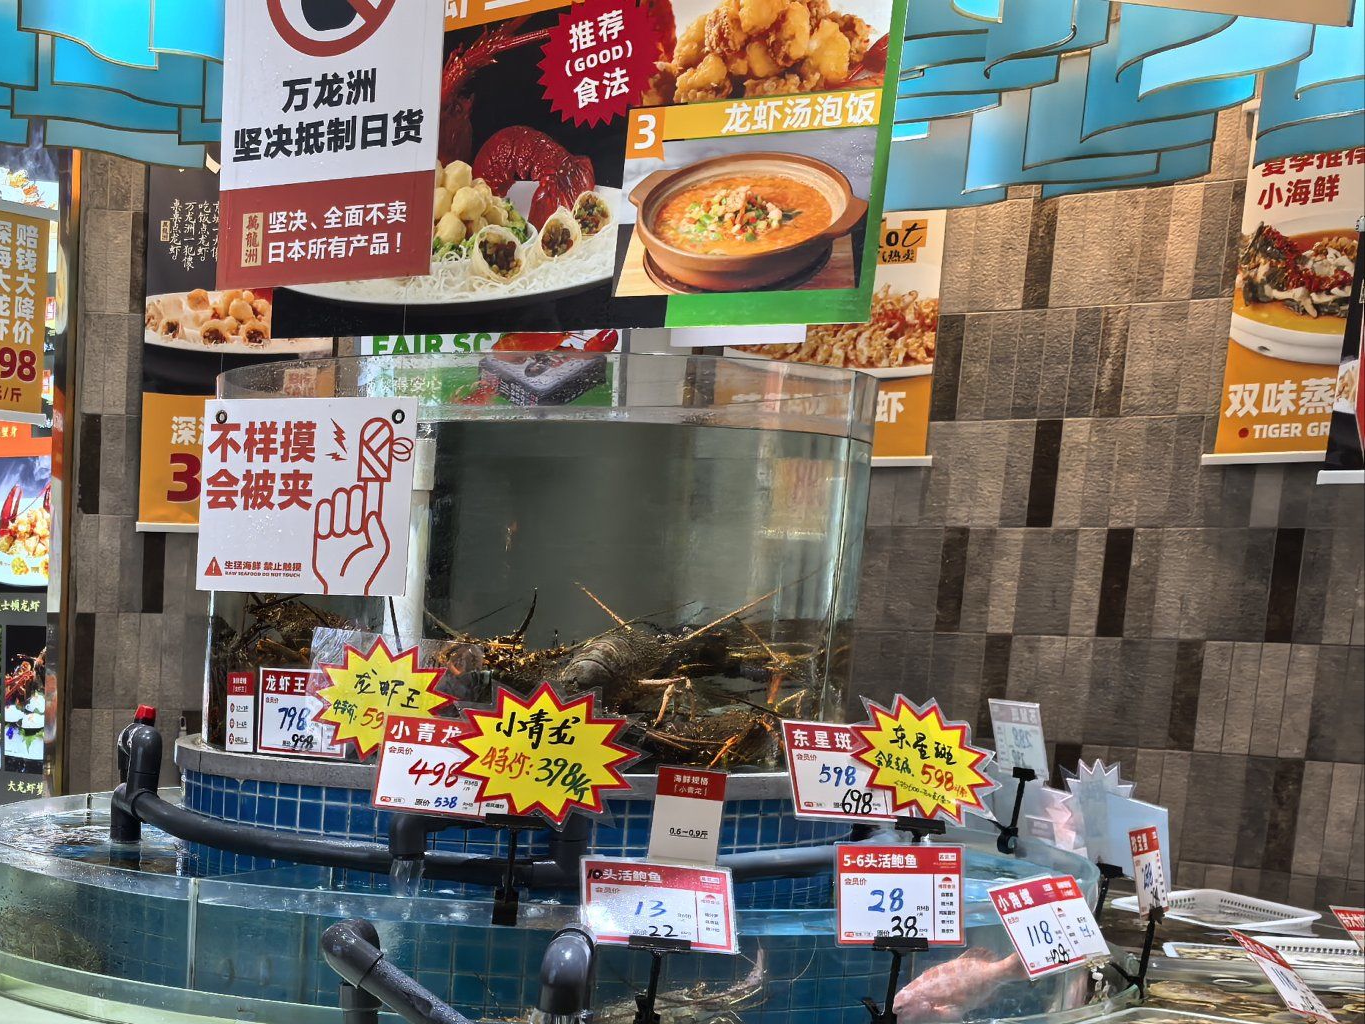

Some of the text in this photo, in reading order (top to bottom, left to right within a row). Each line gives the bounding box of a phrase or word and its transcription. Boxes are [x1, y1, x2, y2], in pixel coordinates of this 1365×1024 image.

[569, 9, 625, 53] 推荐
[564, 40, 633, 77] (GOOD)
[282, 68, 377, 113] 万龙洲
[573, 68, 630, 109] 食法
[720, 91, 876, 134] 龙虾汤泡饭
[233, 109, 424, 162] 坚决抵制日货
[634, 114, 657, 150] 3
[1257, 174, 1340, 209] 小海鲜
[267, 201, 407, 234] 坚决、全面不卖
[244, 214, 260, 264] 萬龍洲
[13, 222, 40, 345] 赔钱大降价
[372, 334, 443, 355] FAIR
[1224, 377, 1336, 420] 双味蒸
[208, 421, 317, 463] 不样摸
[1253, 422, 1302, 439] TIGER
[167, 453, 201, 502] 3
[206, 469, 313, 511] 会被夹
[224, 560, 262, 571] 生猛海鲜
[266, 674, 306, 693] 龙虾王
[353, 669, 421, 709] 龙虾王
[278, 706, 311, 731] 798
[494, 709, 582, 750] 小青龙
[388, 745, 414, 756] 会员价
[792, 729, 853, 750] 东星斑
[889, 724, 958, 766] 东星斑
[796, 753, 817, 762] 会员价
[464, 779, 479, 787] RMB
[673, 774, 709, 786] 海鲜规格
[818, 763, 857, 787] 598
[920, 763, 954, 792] 598
[415, 798, 431, 807] 原价
[434, 796, 458, 810] 538
[841, 788, 873, 815] 698
[843, 854, 918, 870] 5-6头活鲍鱼
[844, 877, 867, 886] 会员价
[634, 900, 668, 918] 13
[867, 888, 905, 913] 28
[648, 924, 679, 937] 22
[891, 915, 919, 938] 38
[1027, 920, 1054, 947] 118
